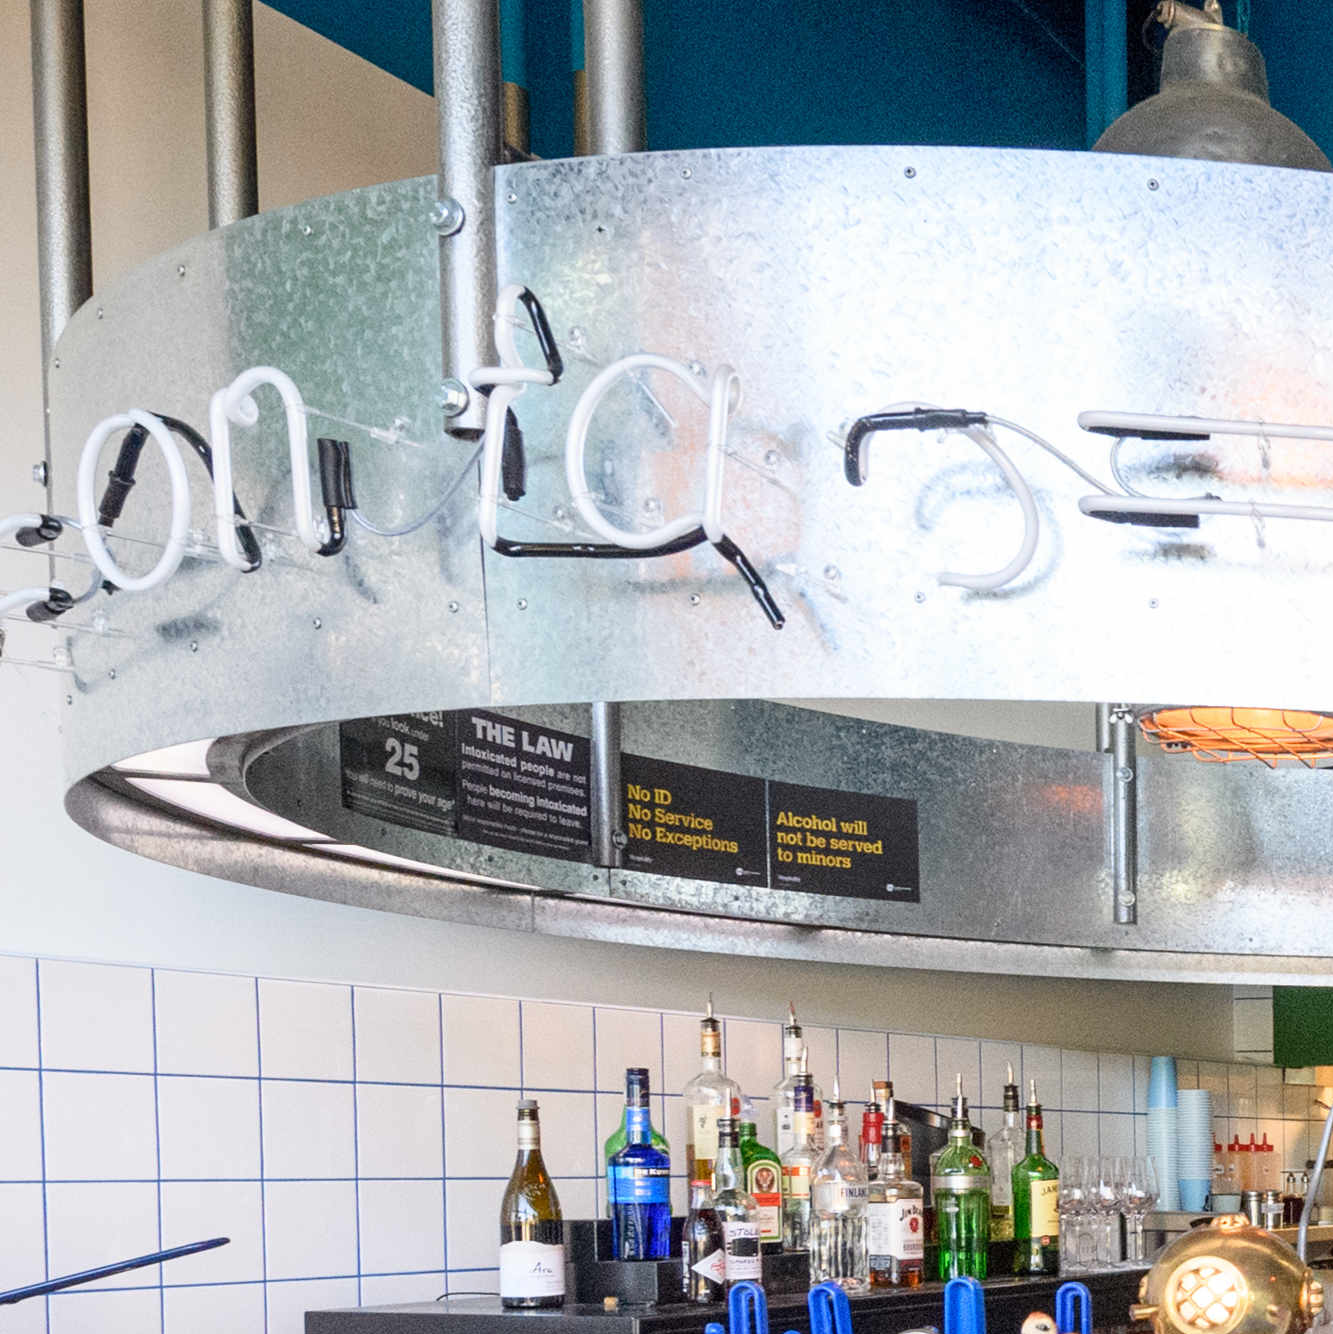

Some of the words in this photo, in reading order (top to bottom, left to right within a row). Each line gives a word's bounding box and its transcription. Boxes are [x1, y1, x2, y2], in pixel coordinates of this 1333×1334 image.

[472, 716, 516, 748] THE
[522, 731, 574, 762] LAW
[384, 737, 420, 780] 25
[461, 743, 517, 768] Intoxicated
[520, 760, 554, 777] people
[489, 784, 535, 807] becoming
[536, 795, 588, 817] intoxicated
[627, 784, 650, 802] No
[654, 788, 672, 805] ID
[627, 804, 651, 821] No
[654, 809, 713, 831] Service
[776, 811, 837, 833] Alcohol
[839, 820, 868, 836] will
[628, 823, 652, 841] No
[655, 827, 739, 853] Exceptions
[776, 831, 804, 847] not
[806, 831, 826, 848] be
[829, 838, 883, 855] served
[777, 848, 793, 863] to
[796, 852, 852, 869] minors
